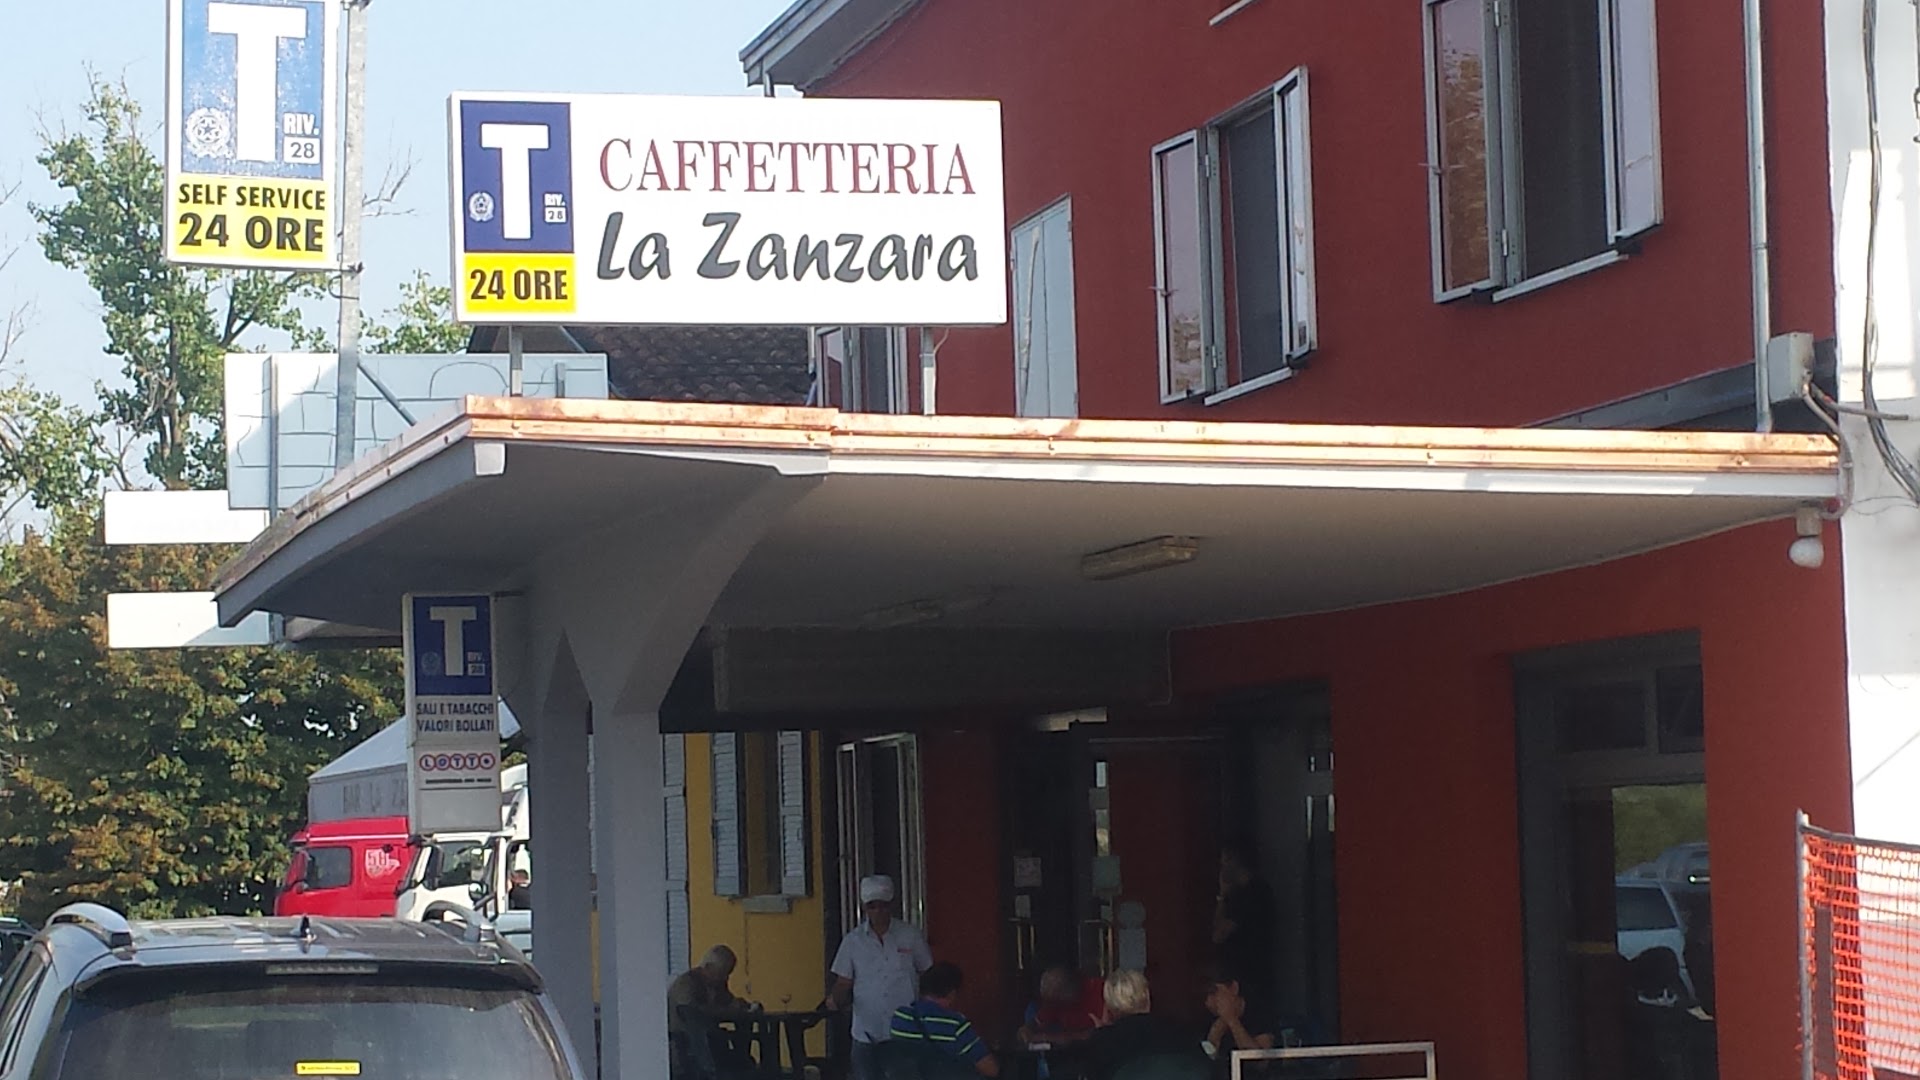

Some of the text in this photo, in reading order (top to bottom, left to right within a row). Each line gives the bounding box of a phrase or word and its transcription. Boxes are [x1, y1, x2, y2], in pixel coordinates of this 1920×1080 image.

[208, 2, 308, 162] T
[283, 112, 320, 135] RIV.
[290, 141, 316, 159] 28
[481, 123, 549, 239] T
[599, 138, 977, 195] CAFFETTERIA
[179, 183, 326, 211] SELF SERVICE
[547, 210, 564, 220] 28
[179, 212, 324, 252] 24 ORE
[596, 212, 979, 283] La Zanzara
[470, 269, 568, 300] 24 ORE
[430, 606, 477, 676] T
[416, 703, 437, 715] SALI
[447, 702, 494, 715] TABACCHI
[416, 719, 495, 732] VALORI BOLLATI
[420, 753, 496, 771] LOTTO
